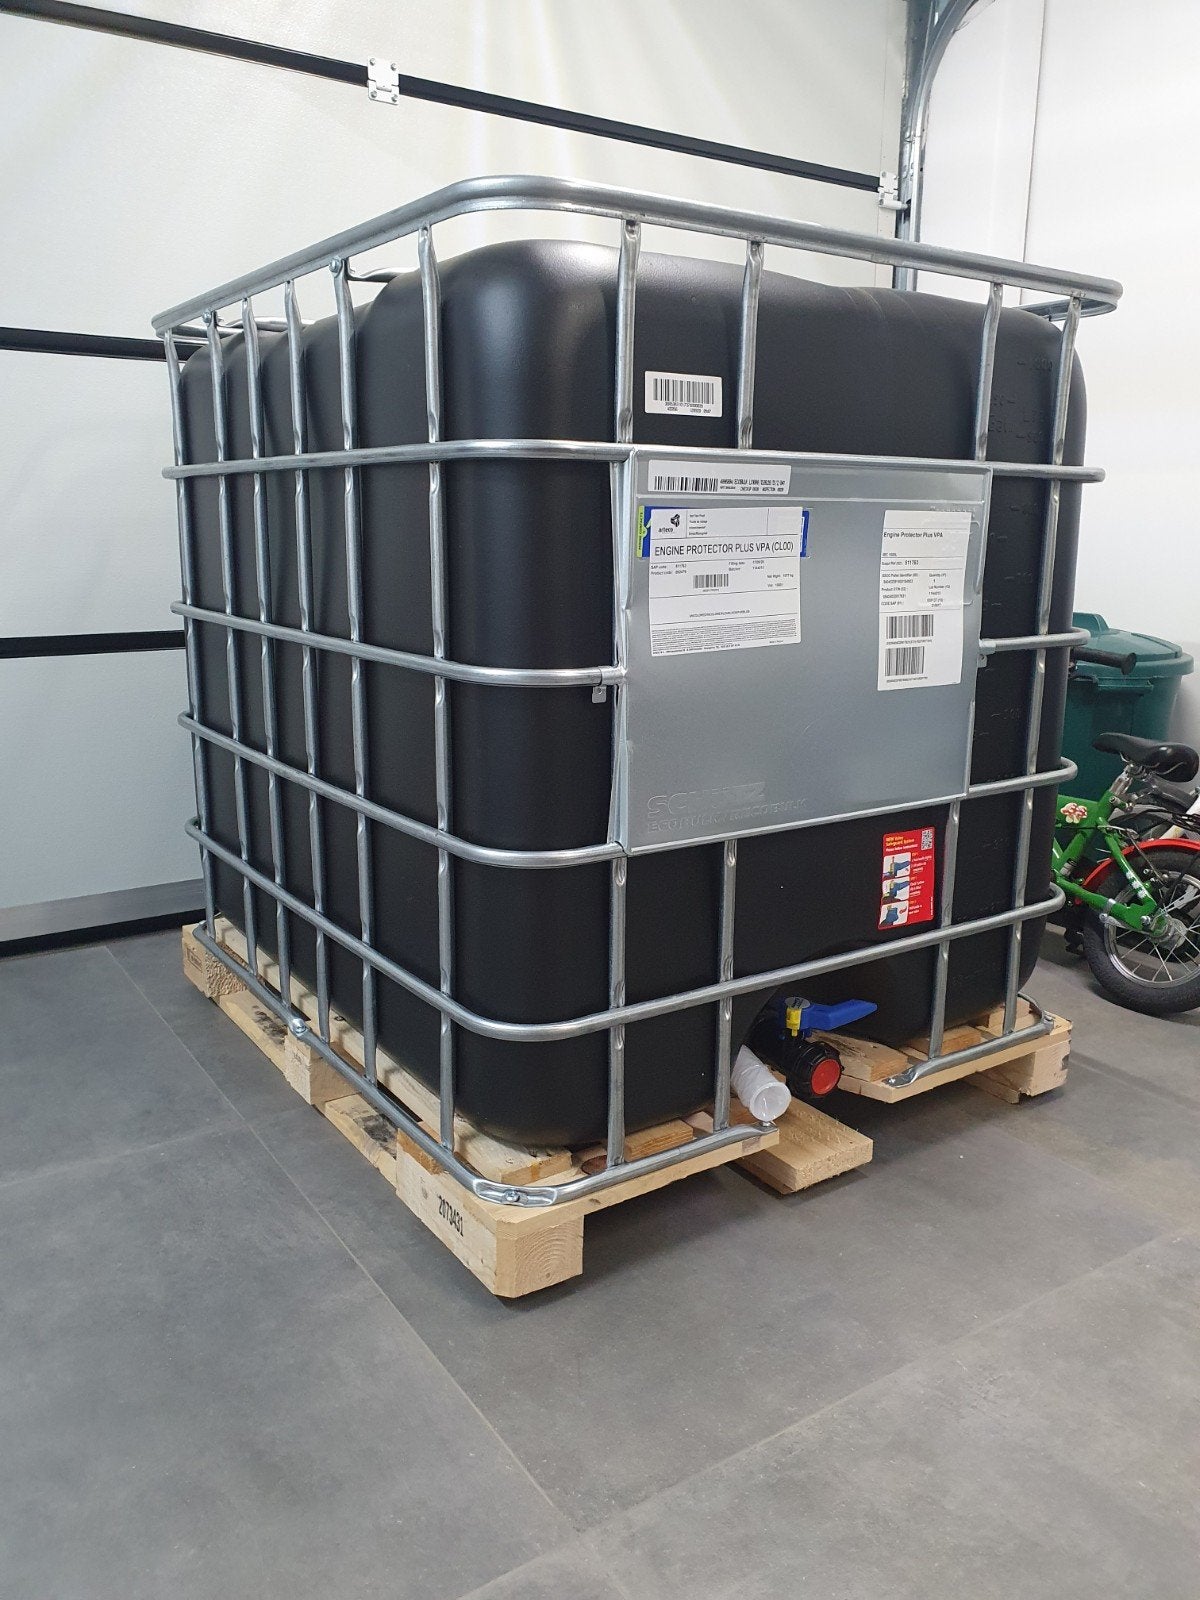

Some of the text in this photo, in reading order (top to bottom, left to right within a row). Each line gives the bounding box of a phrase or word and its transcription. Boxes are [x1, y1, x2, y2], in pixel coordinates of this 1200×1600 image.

[654, 545, 684, 556] ENGINE
[686, 543, 732, 554] PROTECTOR
[736, 542, 754, 553] PLUS
[756, 542, 770, 552] VPA
